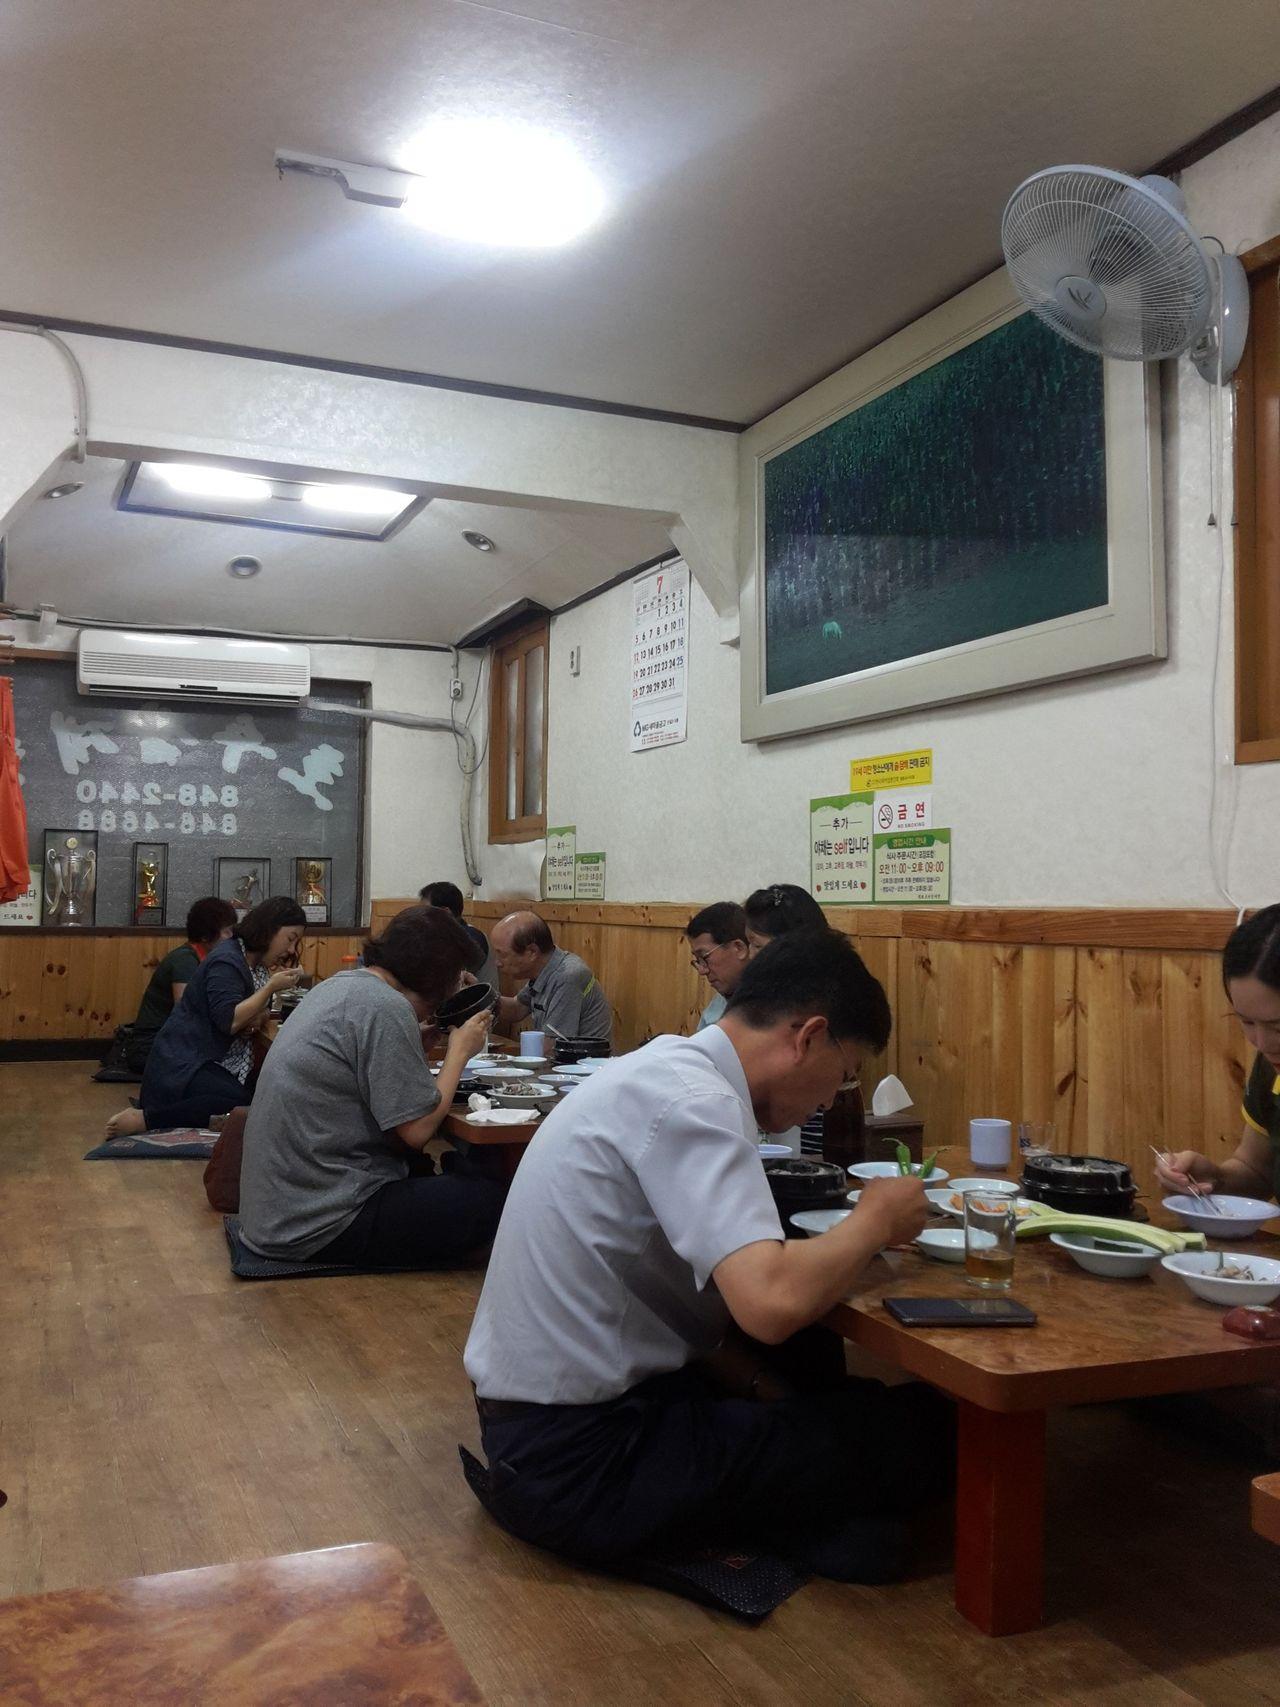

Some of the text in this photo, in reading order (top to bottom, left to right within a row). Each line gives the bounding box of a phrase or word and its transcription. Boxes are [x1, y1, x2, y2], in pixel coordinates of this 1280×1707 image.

[656, 575, 663, 593] 7
[670, 620, 677, 633] 10
[678, 617, 684, 630] 11
[640, 649, 646, 660] 13
[648, 647, 654, 659] 14
[655, 644, 661, 655] 15
[662, 642, 669, 652] 16
[670, 639, 676, 651] 17
[640, 668, 646, 678] 20
[647, 665, 653, 676] 21
[654, 662, 660, 673] 22
[661, 660, 668, 671] 23
[668, 658, 676, 669] 24
[676, 655, 684, 666] 25
[639, 685, 645, 696] 27
[646, 683, 653, 694] 28
[654, 681, 660, 692] 29
[661, 679, 668, 690] 30
[669, 677, 675, 687] 31
[832, 817, 849, 831] 추가
[879, 864, 890, 875] 오전
[911, 862, 924, 873] 오후
[925, 861, 944, 873] 09:00
[841, 879, 859, 890] 드세요
